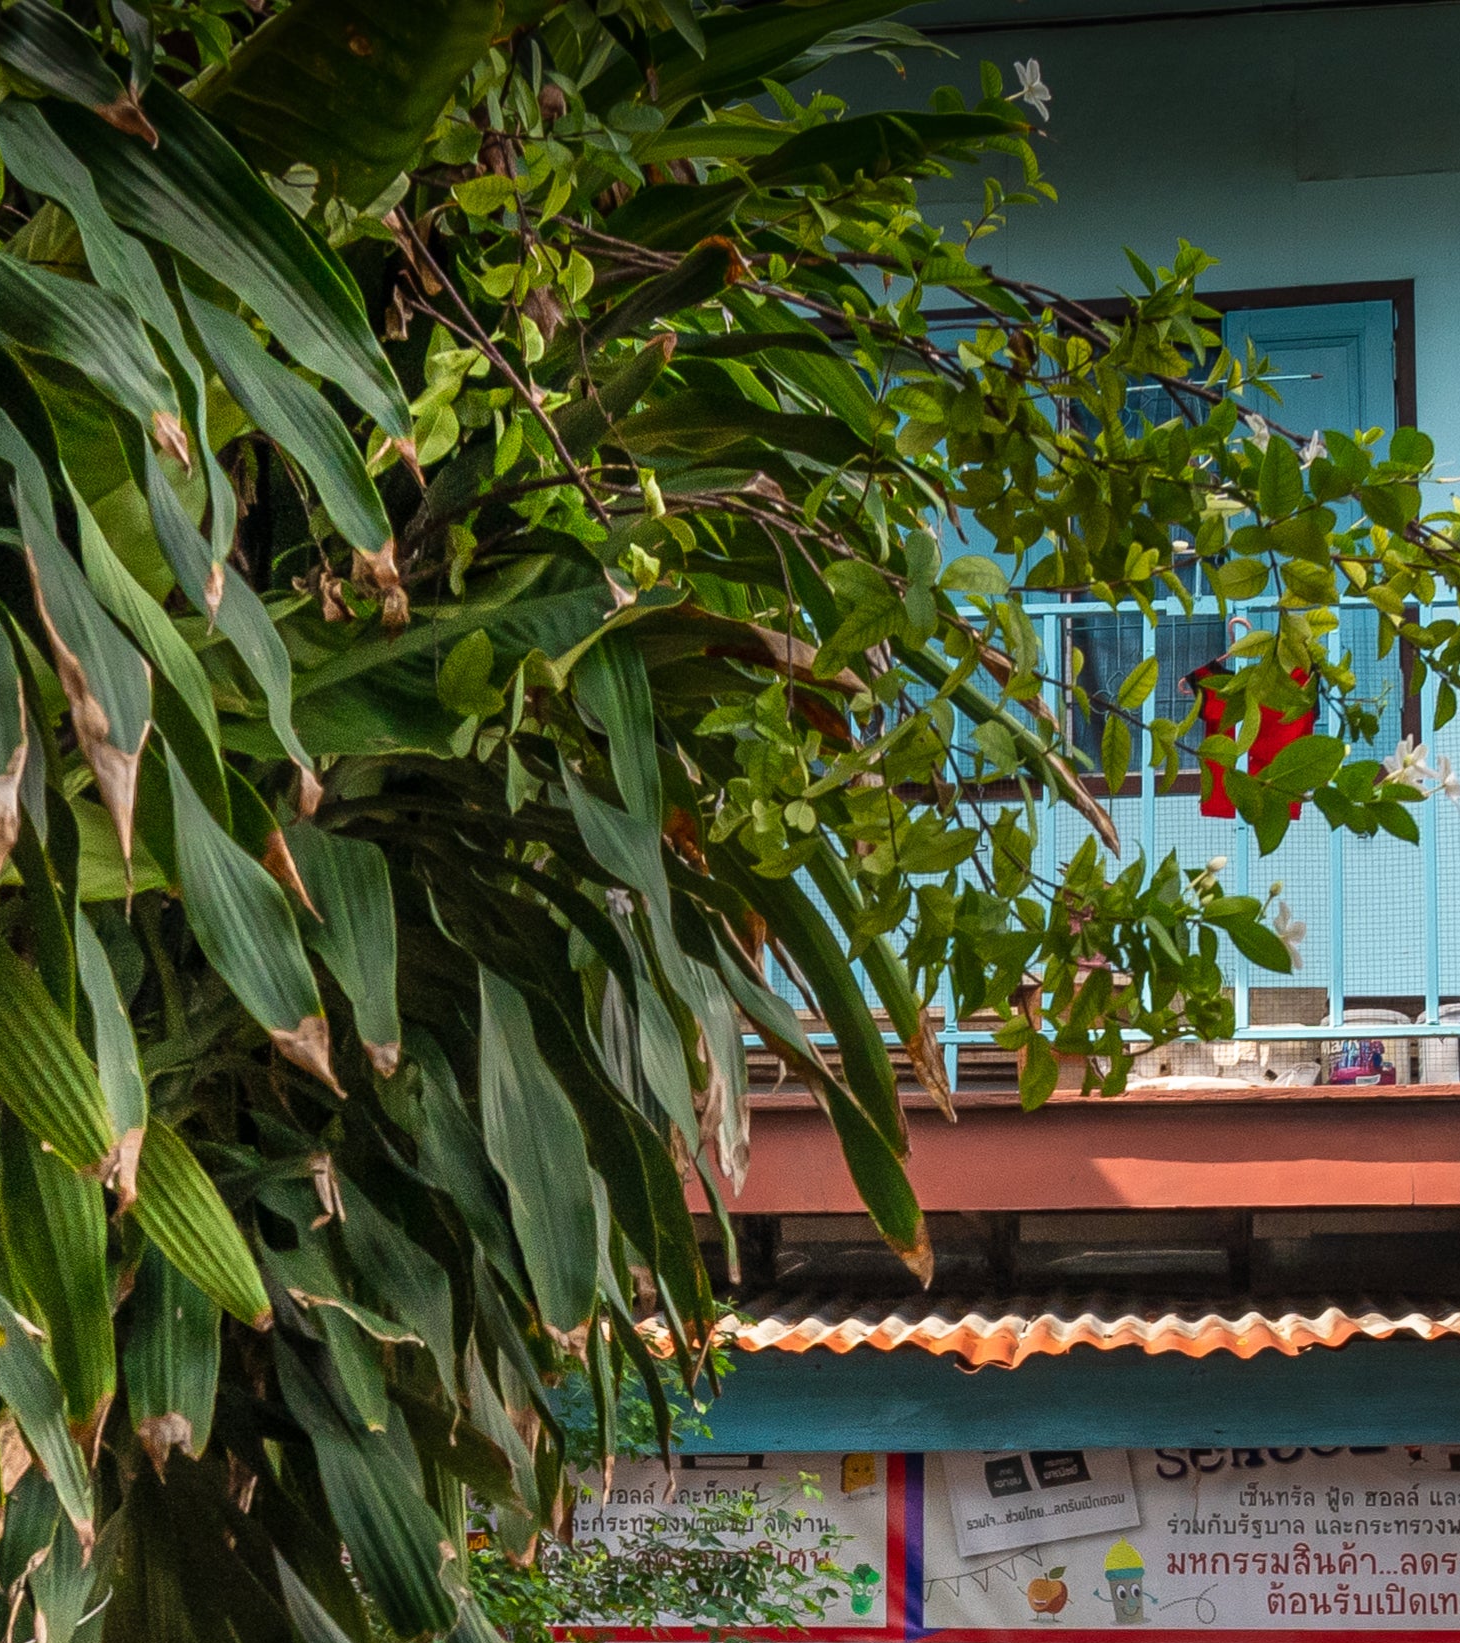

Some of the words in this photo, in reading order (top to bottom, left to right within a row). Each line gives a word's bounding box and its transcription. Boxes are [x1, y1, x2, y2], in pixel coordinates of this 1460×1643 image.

[1239, 1482, 1315, 1507] เซ็นทรัล
[1365, 1483, 1420, 1507] ฮอลล์
[1167, 1513, 1305, 1539] ร่วมกับรัฐบาล
